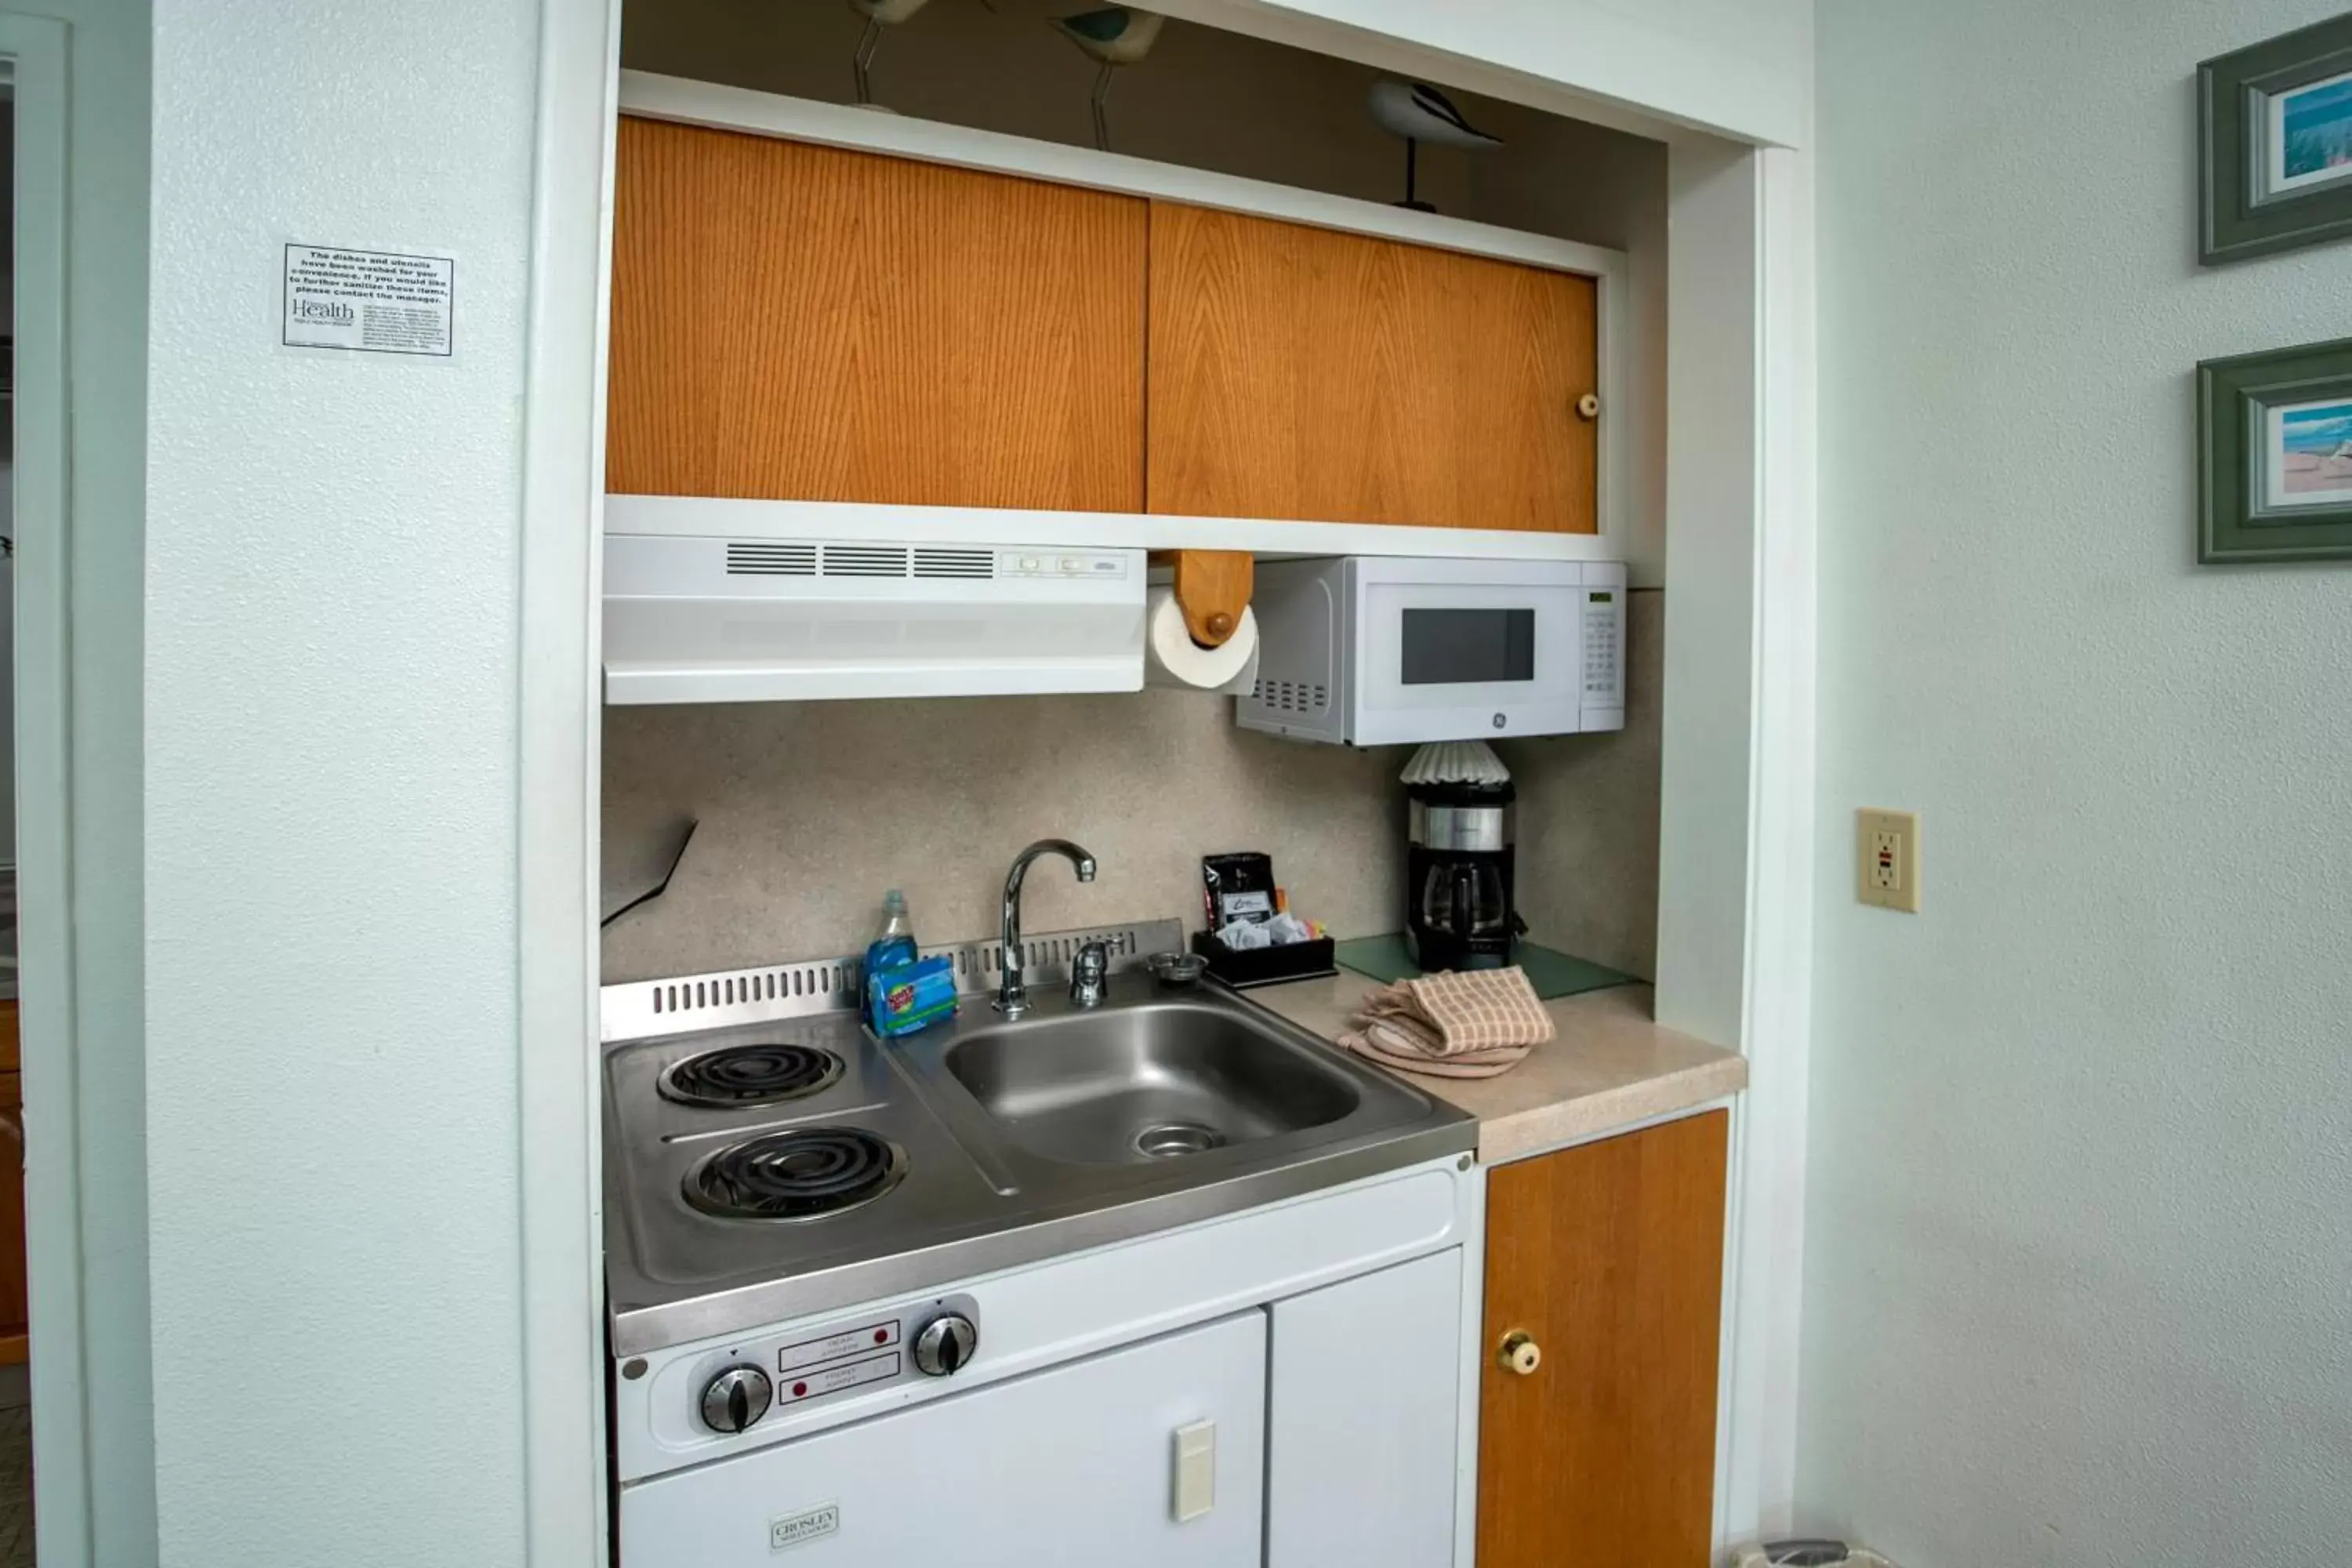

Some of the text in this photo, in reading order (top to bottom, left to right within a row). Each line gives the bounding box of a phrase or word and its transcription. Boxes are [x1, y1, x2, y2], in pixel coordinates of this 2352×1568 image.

[329, 261, 355, 270] been
[358, 265, 397, 274] washed
[332, 253, 366, 263] dishes
[391, 260, 430, 268] utensils
[291, 269, 361, 280] convenience.
[303, 277, 339, 286] further
[343, 281, 383, 290] sanitize
[387, 284, 415, 292] these
[417, 286, 448, 297] items,
[333, 289, 373, 298] contact
[396, 294, 441, 303] manager.
[293, 299, 354, 318] Health
[775, 1511, 833, 1536] CROSLEY
